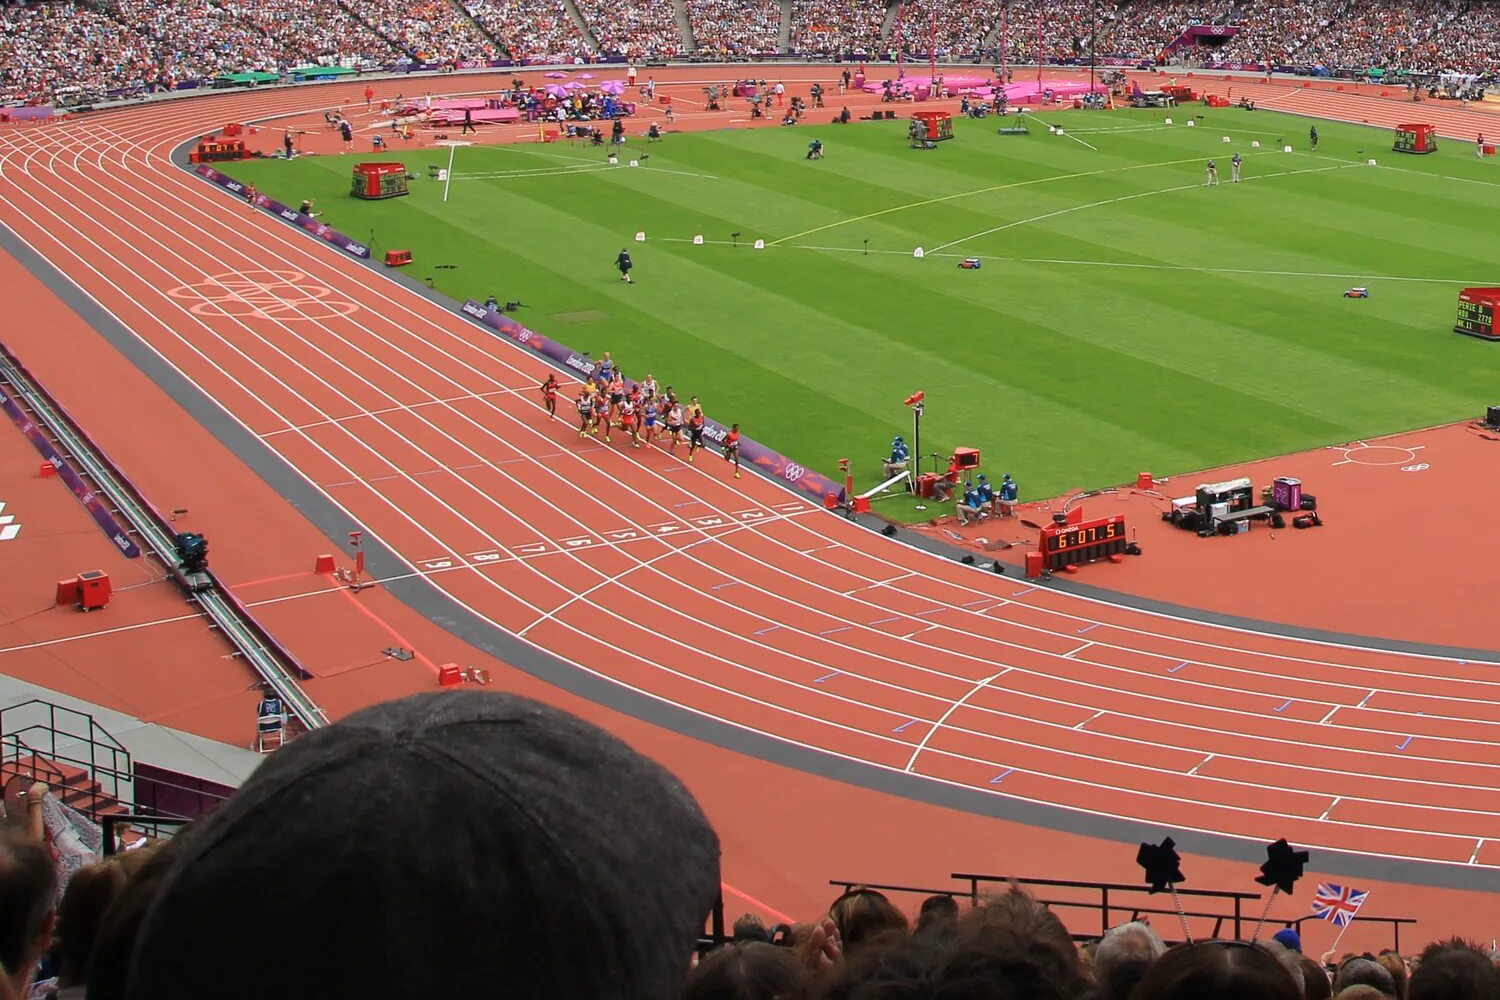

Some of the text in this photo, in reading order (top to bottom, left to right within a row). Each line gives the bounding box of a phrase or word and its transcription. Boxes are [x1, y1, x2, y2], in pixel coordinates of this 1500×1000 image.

[1459, 301, 1476, 311] PERIE
[657, 525, 680, 533] 4
[1059, 524, 1114, 548] 6:07.5
